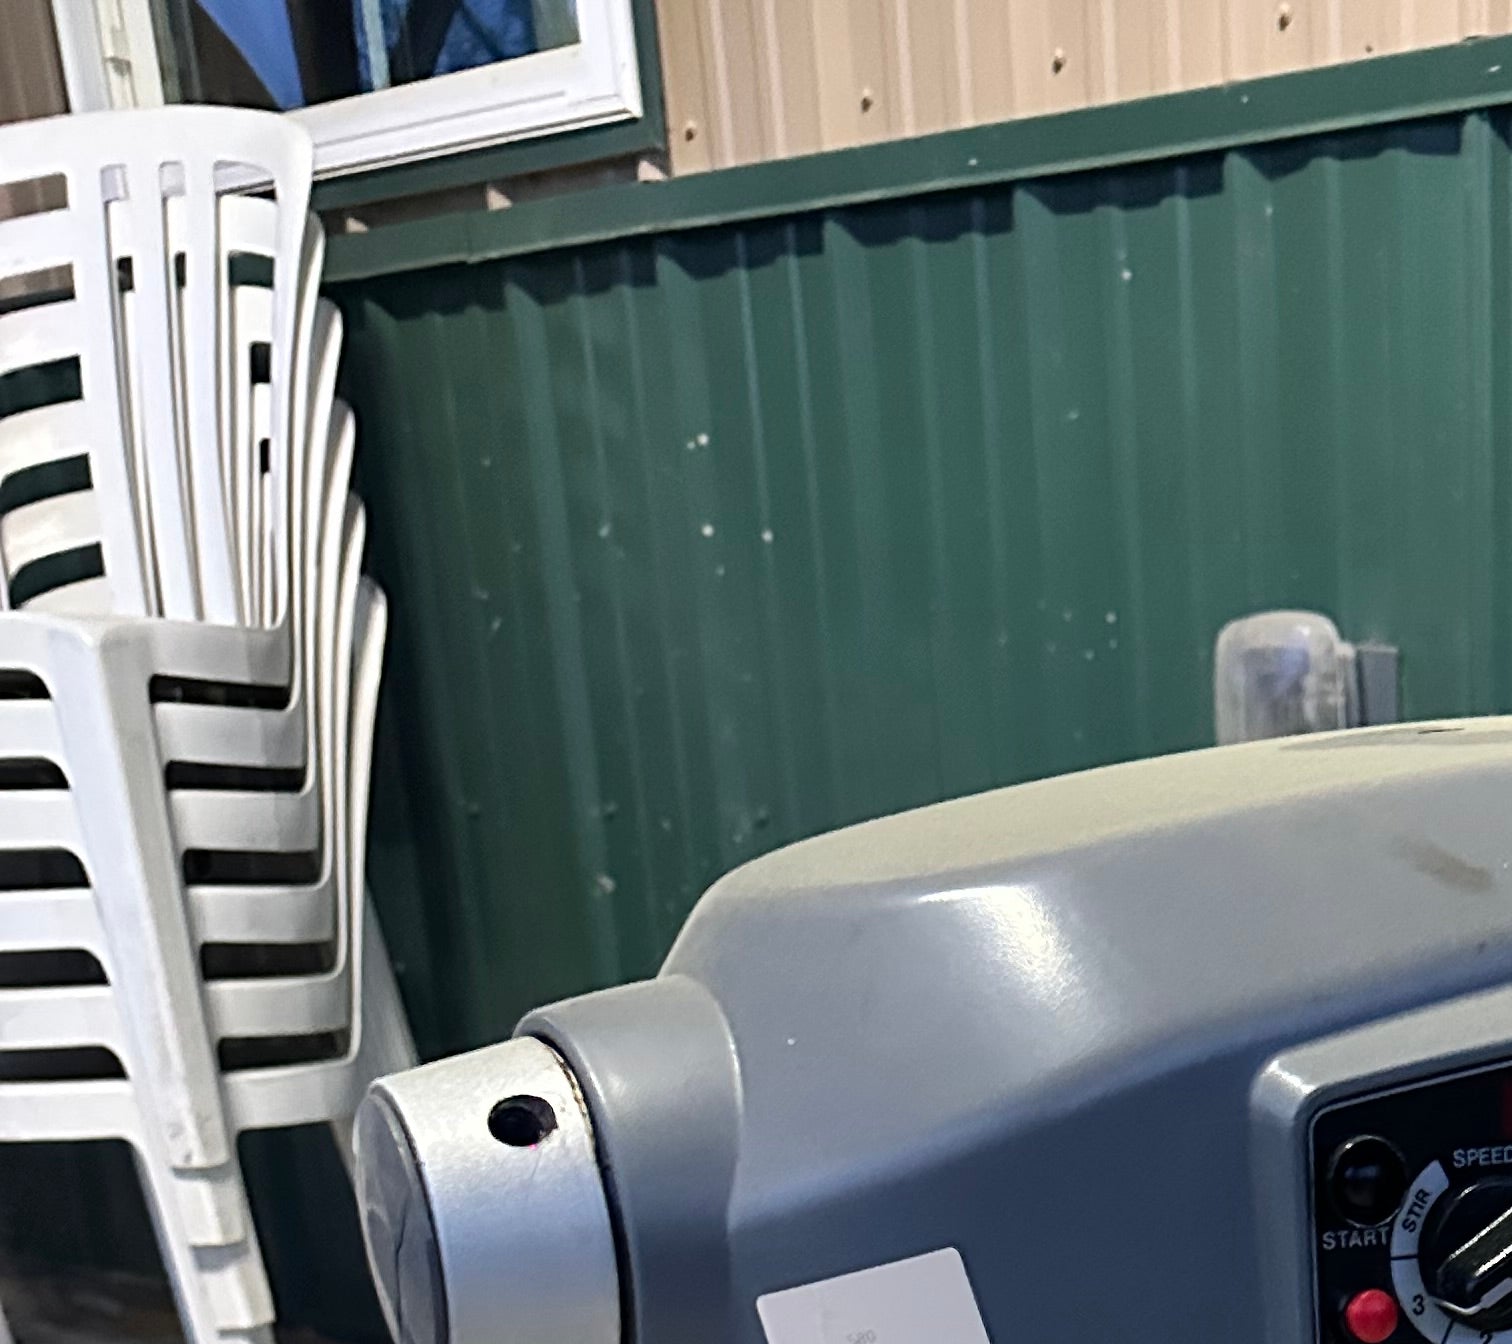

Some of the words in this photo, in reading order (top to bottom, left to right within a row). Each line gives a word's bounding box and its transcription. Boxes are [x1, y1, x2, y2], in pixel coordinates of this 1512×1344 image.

[1402, 1188, 1431, 1233] STIR
[1322, 1227, 1390, 1250] START
[1412, 1294, 1425, 1316] 3
